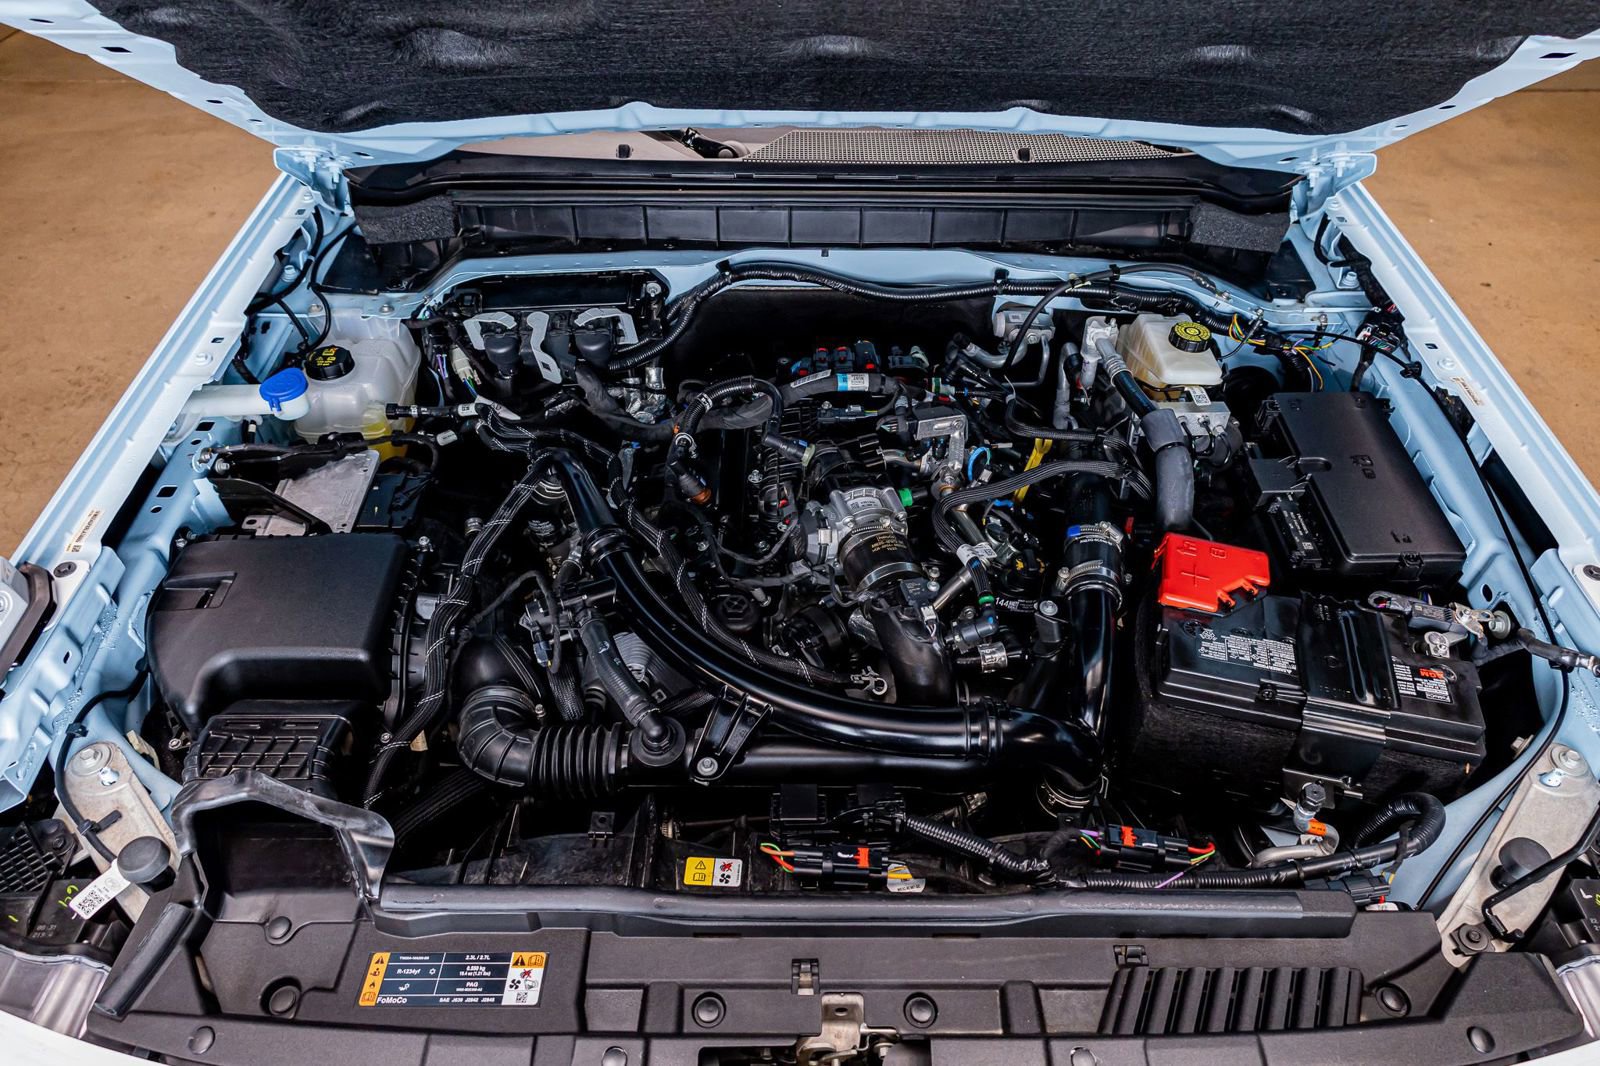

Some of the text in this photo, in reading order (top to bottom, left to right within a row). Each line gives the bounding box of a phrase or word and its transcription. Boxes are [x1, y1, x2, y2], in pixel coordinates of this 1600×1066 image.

[995, 597, 1009, 606] 144
[1420, 668, 1444, 679] AGM
[376, 996, 408, 1004] FoMoCo
